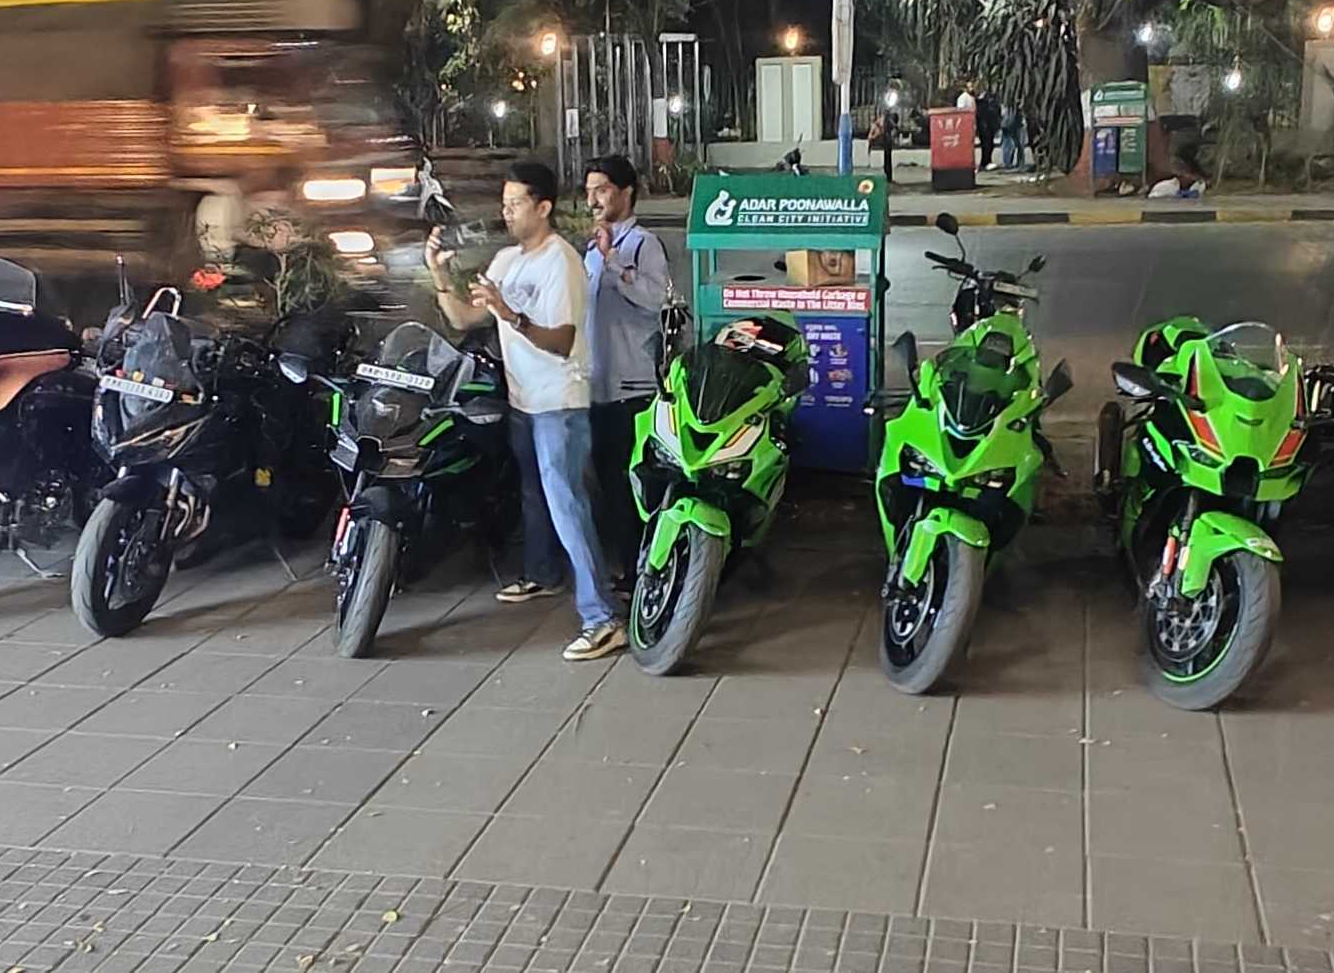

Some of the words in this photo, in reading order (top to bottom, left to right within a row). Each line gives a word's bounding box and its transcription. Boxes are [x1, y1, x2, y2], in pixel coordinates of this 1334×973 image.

[739, 199, 776, 211] ADAR
[779, 199, 869, 211] POONAWALLA
[738, 214, 774, 223] CLEAN
[779, 214, 802, 223] CITY
[807, 214, 868, 223] INITIATIVE
